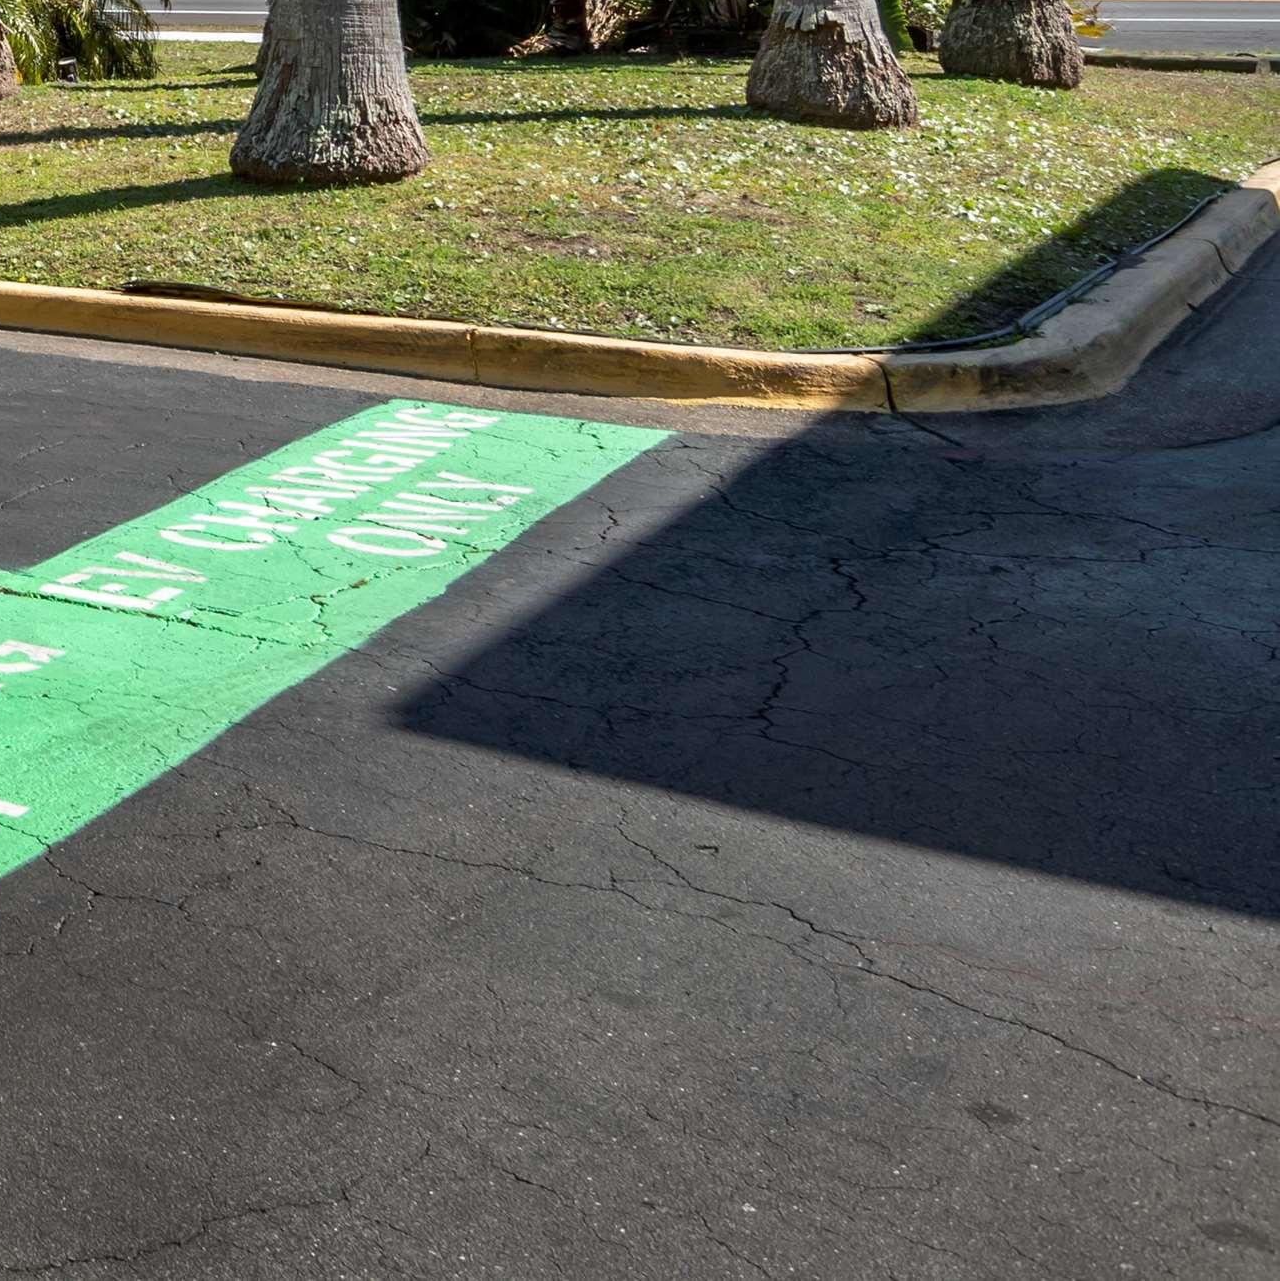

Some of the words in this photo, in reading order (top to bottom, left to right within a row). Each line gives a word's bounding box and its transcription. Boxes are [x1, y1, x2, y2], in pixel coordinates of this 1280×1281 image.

[40, 550, 209, 611] EV
[160, 407, 501, 552] CHARGING
[326, 471, 535, 558] ONLY
